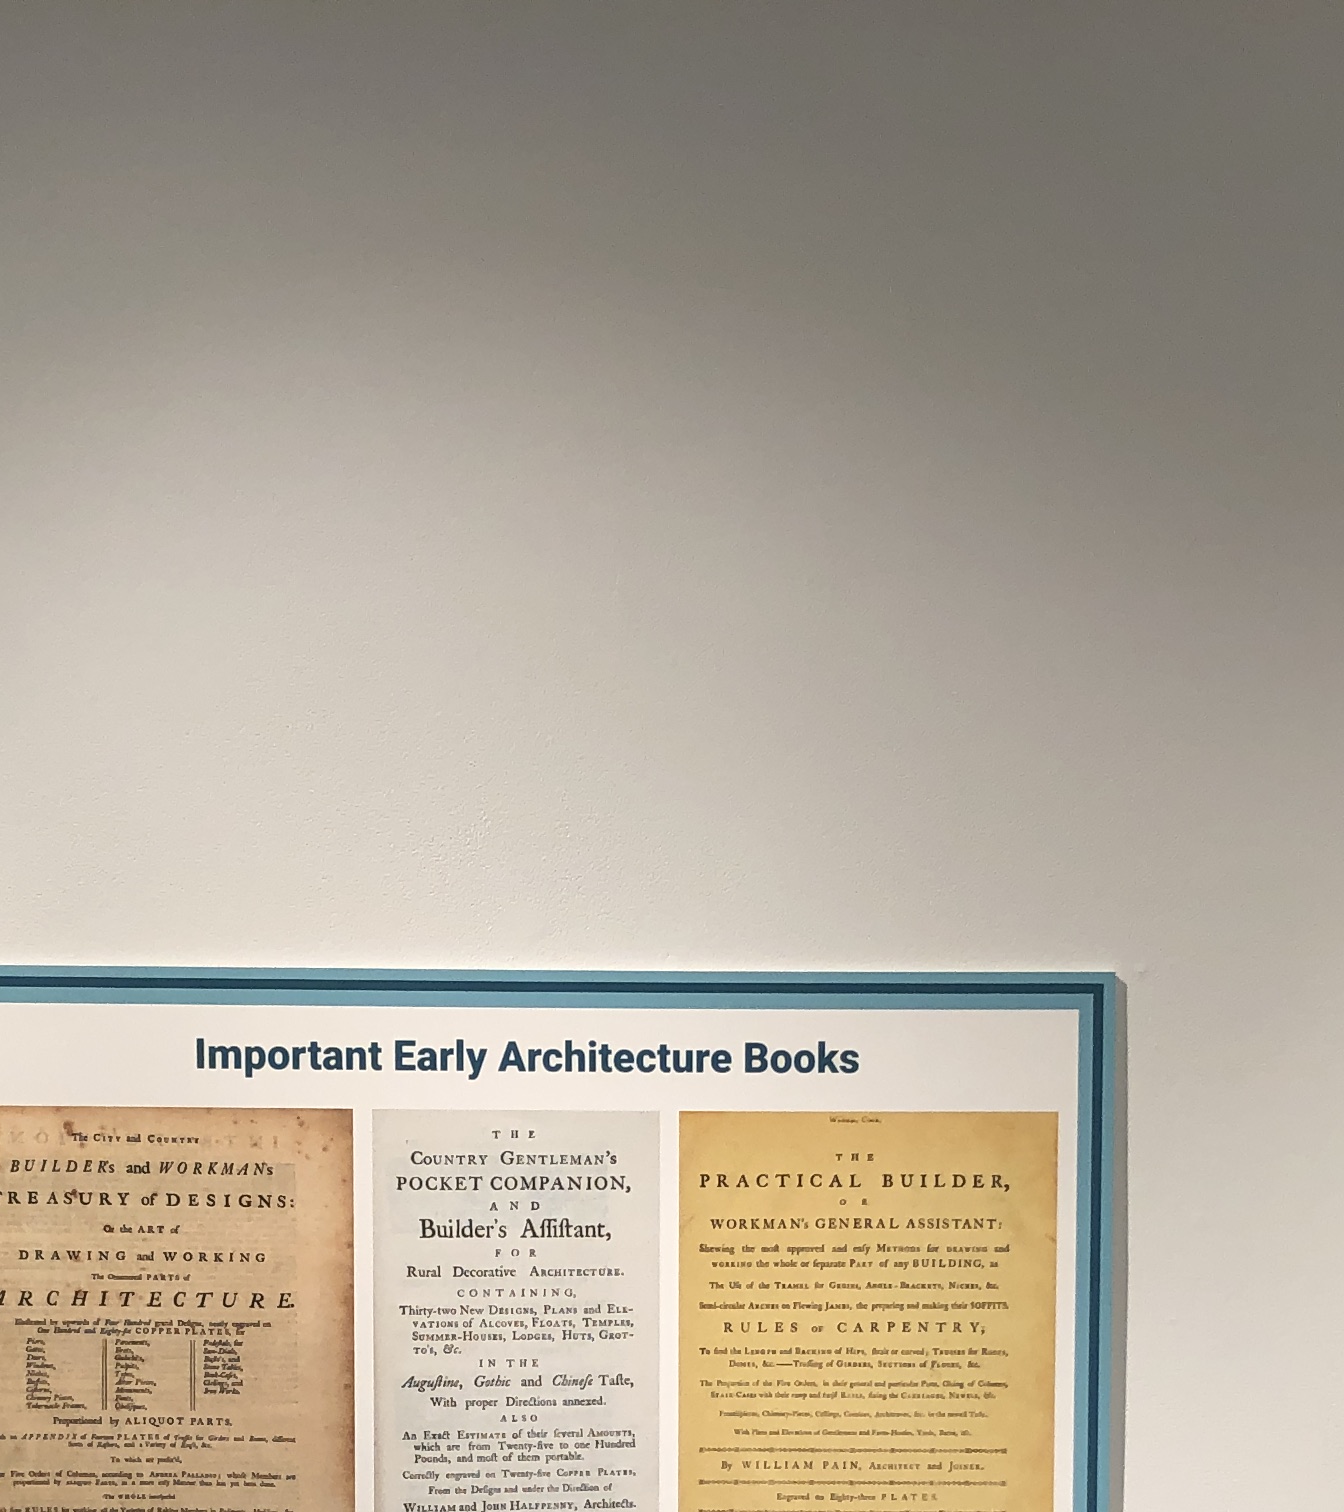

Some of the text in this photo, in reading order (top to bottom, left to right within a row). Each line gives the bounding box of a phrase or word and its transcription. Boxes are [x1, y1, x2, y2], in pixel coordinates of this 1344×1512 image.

[196, 1037, 859, 1080] Important Early Architecture Books
[491, 1129, 535, 1139] THE
[835, 1152, 874, 1161] THE
[125, 1160, 151, 1175] and
[396, 1175, 631, 1193] POCKET COMPANION,
[699, 1173, 1010, 1192] PRACTICAL BUILDER,
[141, 1192, 158, 1206] of
[489, 1200, 540, 1211] AND
[418, 1218, 507, 1239] Builder's
[814, 1217, 899, 1229] GENERAL
[18, 1249, 265, 1263] DRAWING and WORKING
[494, 1248, 536, 1257] FOR
[406, 1265, 441, 1277] Rural
[452, 1265, 516, 1277] Decorative
[723, 1321, 798, 1333] RULES
